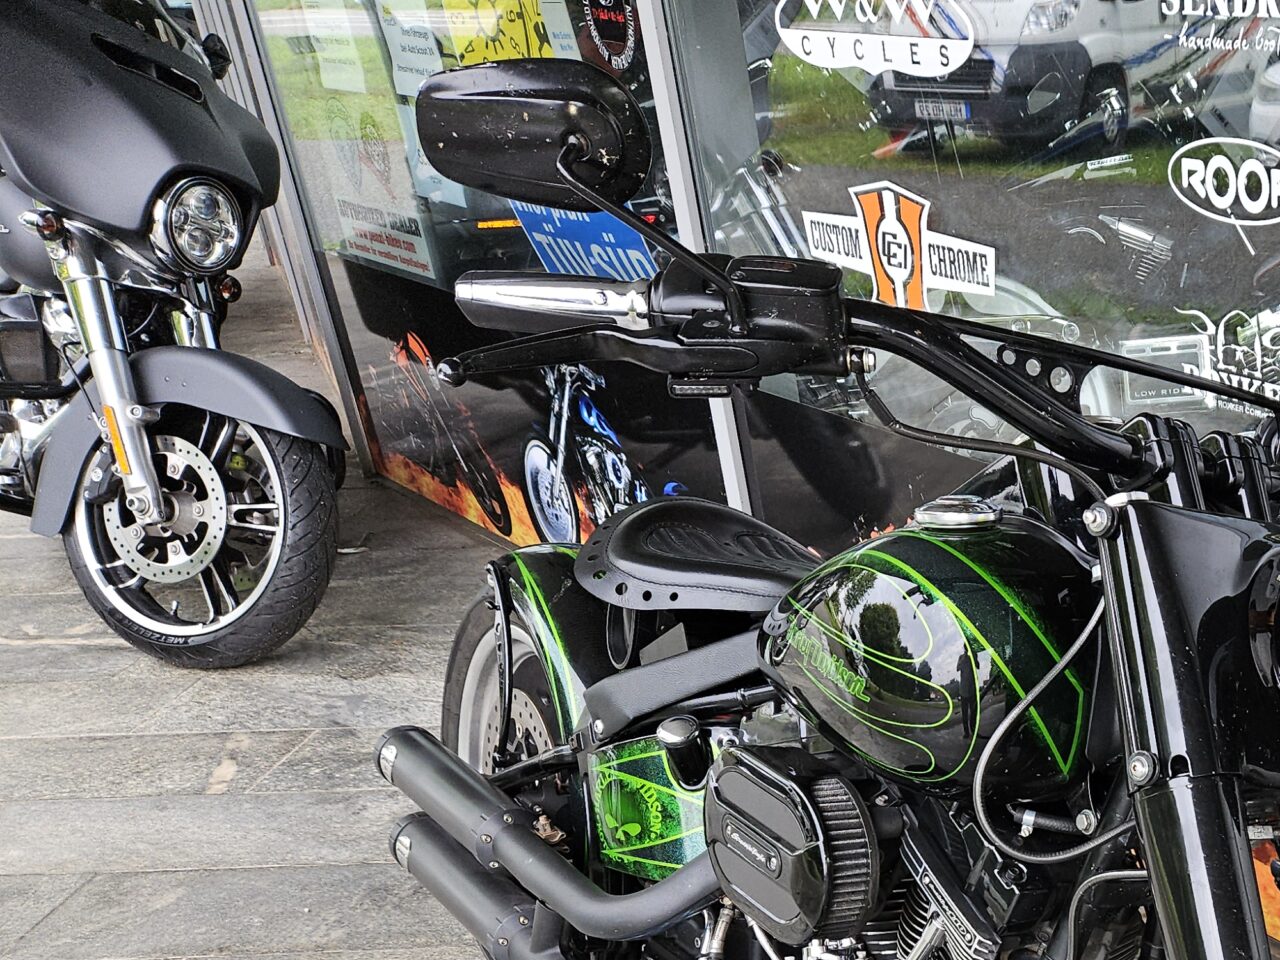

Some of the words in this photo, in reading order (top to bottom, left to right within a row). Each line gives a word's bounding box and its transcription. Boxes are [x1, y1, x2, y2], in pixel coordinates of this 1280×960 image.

[801, 35, 950, 67] CYCLES
[1179, 21, 1249, 50] handmade
[810, 219, 862, 260] CUSTOM
[928, 243, 990, 287] CHROME
[1135, 390, 1157, 398] LOW
